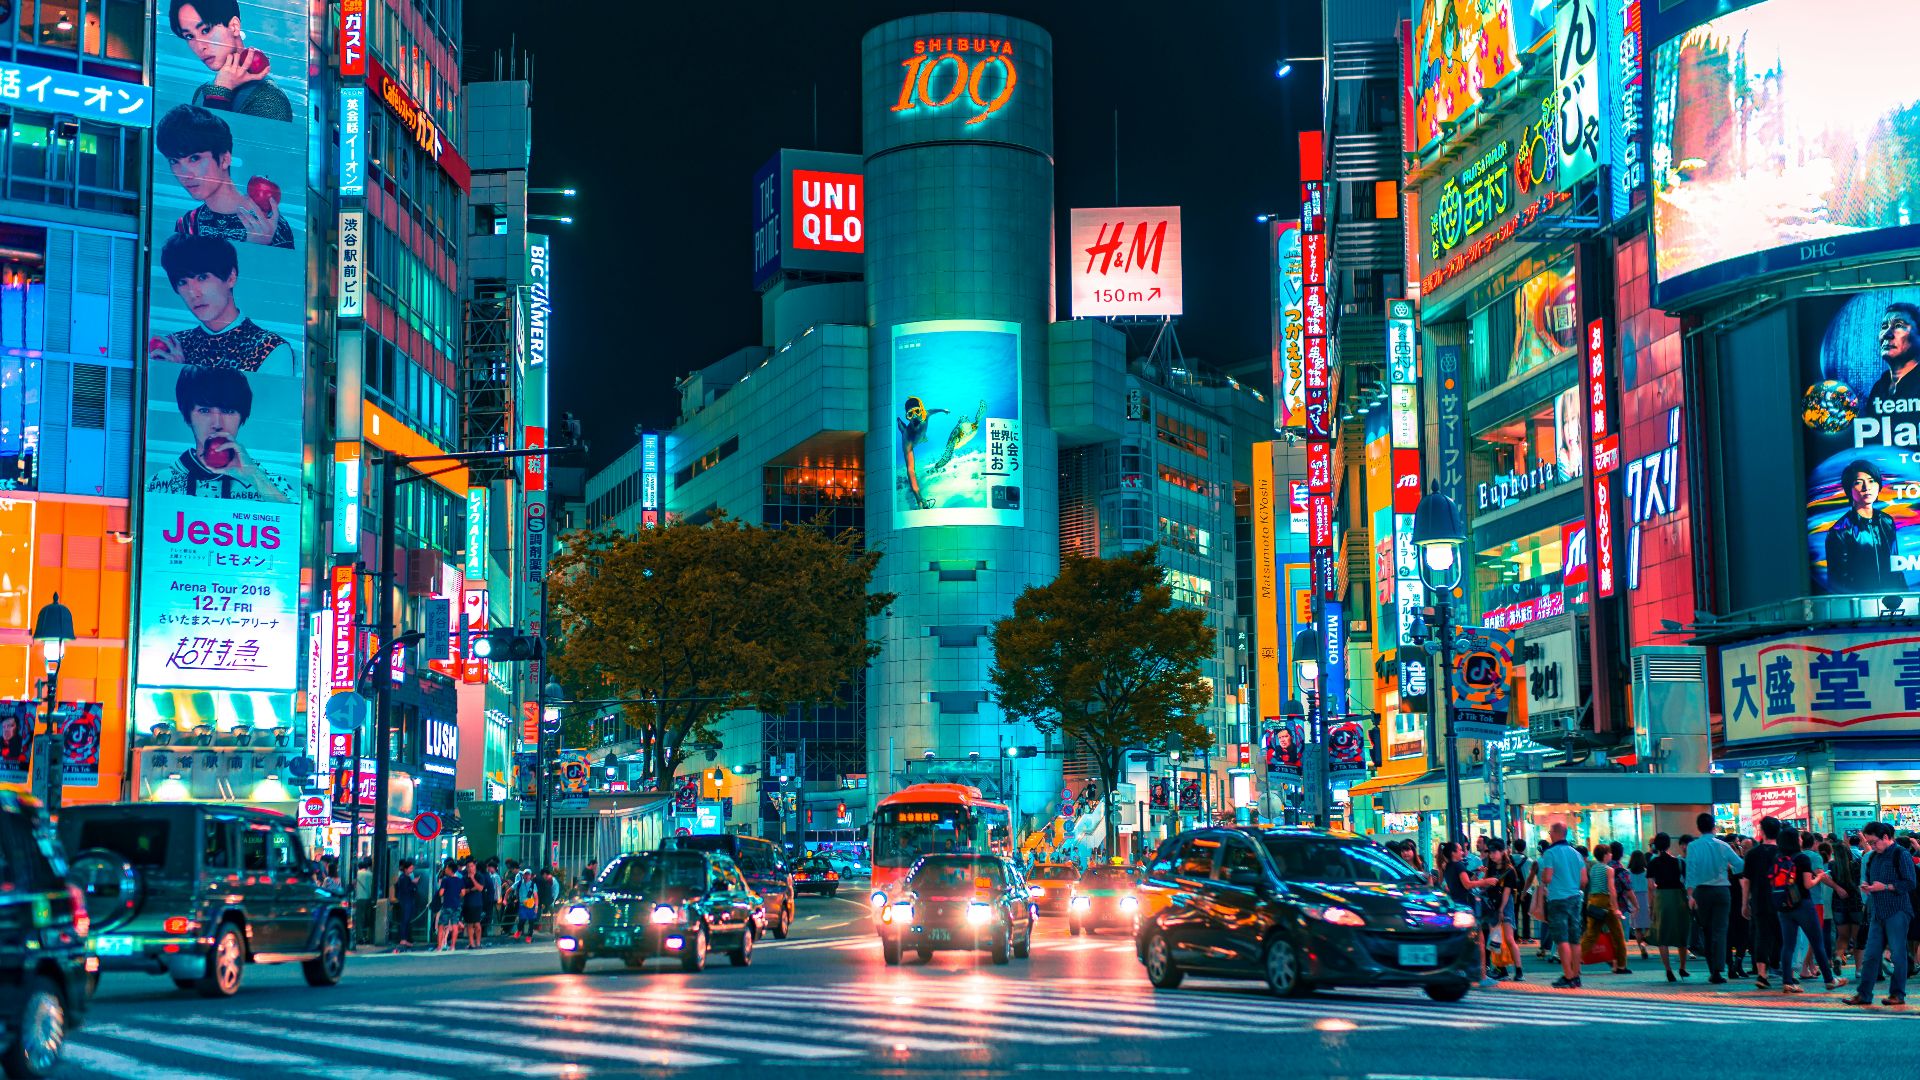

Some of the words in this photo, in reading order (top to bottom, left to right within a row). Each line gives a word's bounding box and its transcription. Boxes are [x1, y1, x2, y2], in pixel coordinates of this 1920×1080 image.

[345, 13, 362, 64] ガスト
[914, 38, 1015, 56] SHIBUYA
[382, 76, 399, 108] Café
[890, 52, 1017, 125] 109
[345, 98, 359, 186] 英会話イーオン
[416, 110, 443, 161] ガスト
[759, 173, 776, 212] THE
[802, 180, 857, 211] UNI
[1464, 162, 1509, 237] 西村
[755, 214, 780, 272] PRIME
[802, 213, 862, 245] QLO
[344, 218, 358, 308] 渋谷駅前ビル
[530, 245, 545, 278] BIC
[1085, 220, 1168, 276] H&M
[1800, 242, 1836, 261] DHC
[1094, 288, 1143, 303] 150m
[530, 282, 552, 366] CAMERA
[990, 429, 1019, 442] 世界に
[1854, 415, 1920, 448] Pla
[991, 442, 1019, 457] 出会
[991, 457, 1019, 472] おう
[1396, 474, 1418, 488] JTB
[1478, 458, 1554, 510] Euphoria
[162, 511, 281, 550] Jesus
[232, 512, 250, 520] NEW
[252, 514, 280, 522] SINGLE
[527, 502, 546, 532] OS
[529, 533, 543, 584] 調剤薬局
[1261, 527, 1271, 599] Matsumoto
[170, 581, 207, 593] Arena
[212, 583, 238, 594] Tour
[241, 585, 271, 596] 2018
[192, 596, 231, 612] 12.7
[234, 603, 253, 613] FRI
[159, 613, 279, 629] さいたまスーパーアリーナ
[1401, 598, 1411, 631] フルーツ
[166, 636, 269, 672] 超特急
[335, 600, 351, 680] サンドラッグ
[1327, 614, 1339, 665] MIZUHO
[468, 667, 479, 675] 3F
[1407, 660, 1427, 697] HUB
[1480, 714, 1494, 723] Tok
[426, 719, 458, 760] LUSH
[1739, 759, 1769, 767] TAISEIDO
